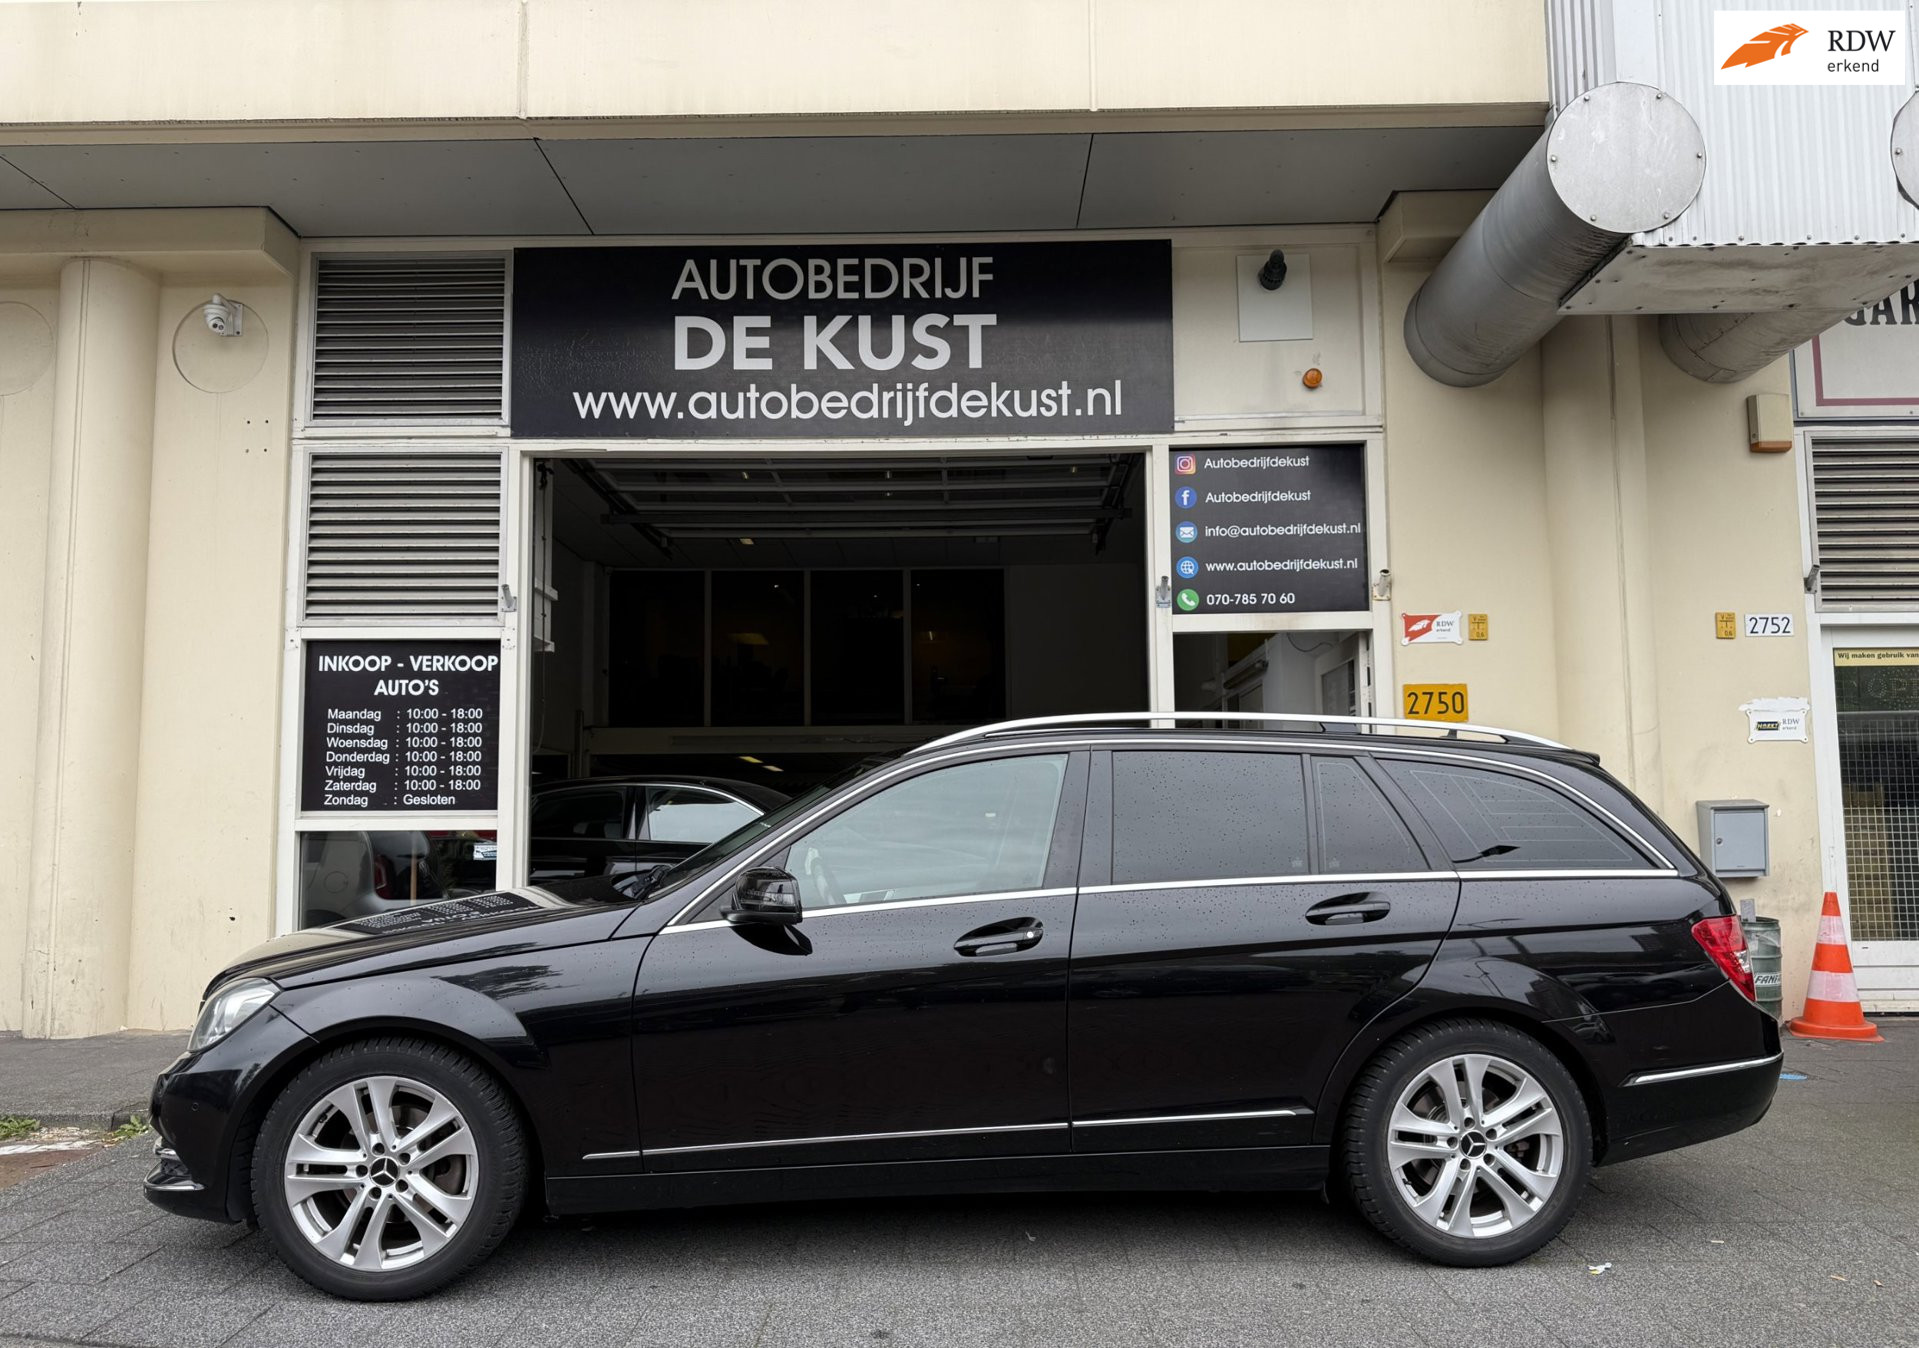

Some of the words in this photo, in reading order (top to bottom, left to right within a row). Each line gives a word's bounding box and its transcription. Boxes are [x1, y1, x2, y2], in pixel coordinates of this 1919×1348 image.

[671, 257, 994, 300] AUTOBEDRIJF
[1844, 278, 1919, 327] AR
[674, 316, 773, 371] DE
[803, 313, 997, 371] KUST
[572, 380, 1123, 426] www.autobedrijfdekust.nl
[1204, 456, 1310, 470] Autobedrijfdekust
[1205, 490, 1312, 504] Autobedrijfdekust
[1205, 523, 1361, 538] info@autobedrijfdekust.nl
[1205, 558, 1358, 573] www.autobedrijfdekust.nl
[1206, 594, 1257, 605] 070-785
[1261, 593, 1276, 604] 70
[1279, 593, 1296, 604] 60
[1749, 617, 1791, 634] 2752
[1838, 652, 1849, 660] Wij
[318, 655, 392, 672] INKOOP
[410, 655, 499, 672] VERKOOP
[374, 679, 439, 696] AUTO'S
[1407, 691, 1464, 714] 2750
[328, 709, 381, 721] Maandag
[407, 709, 438, 719] 10:00
[451, 709, 482, 719] 18:00
[327, 723, 374, 735] Dinsdag
[406, 723, 438, 733] 10:00
[450, 723, 482, 733] 18:00
[327, 737, 388, 749] Woensdag
[406, 737, 438, 747] 10:00
[450, 737, 482, 747] 18:00
[326, 752, 389, 764] Donderdag
[405, 751, 437, 761] 10:00
[450, 751, 481, 761] 18:00
[326, 766, 365, 778] Vrijdag
[405, 766, 436, 776] 10:00
[449, 766, 481, 775] 18:00
[325, 780, 376, 792] Zaterdag
[404, 780, 436, 790] 10:00
[449, 780, 480, 790] 18:00
[324, 795, 368, 807] Zondag
[403, 794, 455, 805] Gesloten
